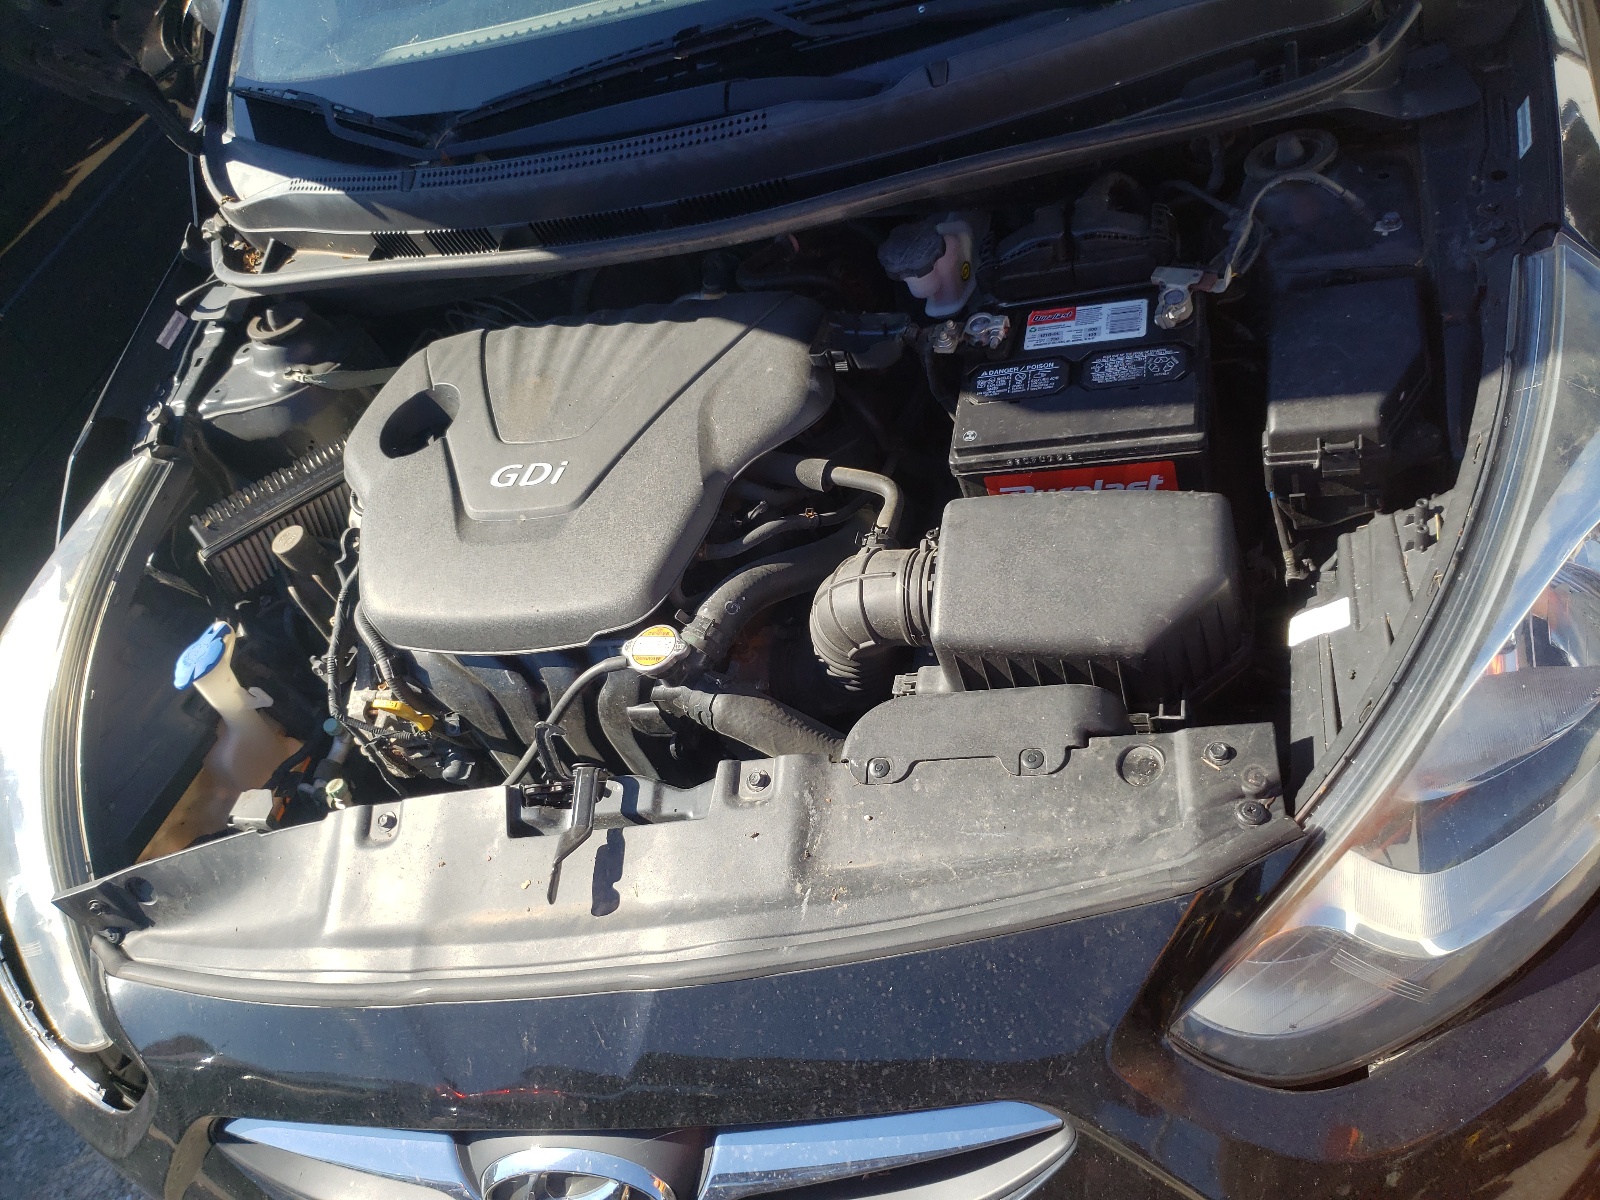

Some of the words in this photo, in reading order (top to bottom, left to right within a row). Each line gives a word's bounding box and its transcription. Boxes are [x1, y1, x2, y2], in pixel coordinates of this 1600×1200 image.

[1033, 311, 1073, 323] Duralast
[988, 366, 1019, 376] DANGER
[1026, 362, 1055, 371] POISON
[490, 460, 569, 487] GDi
